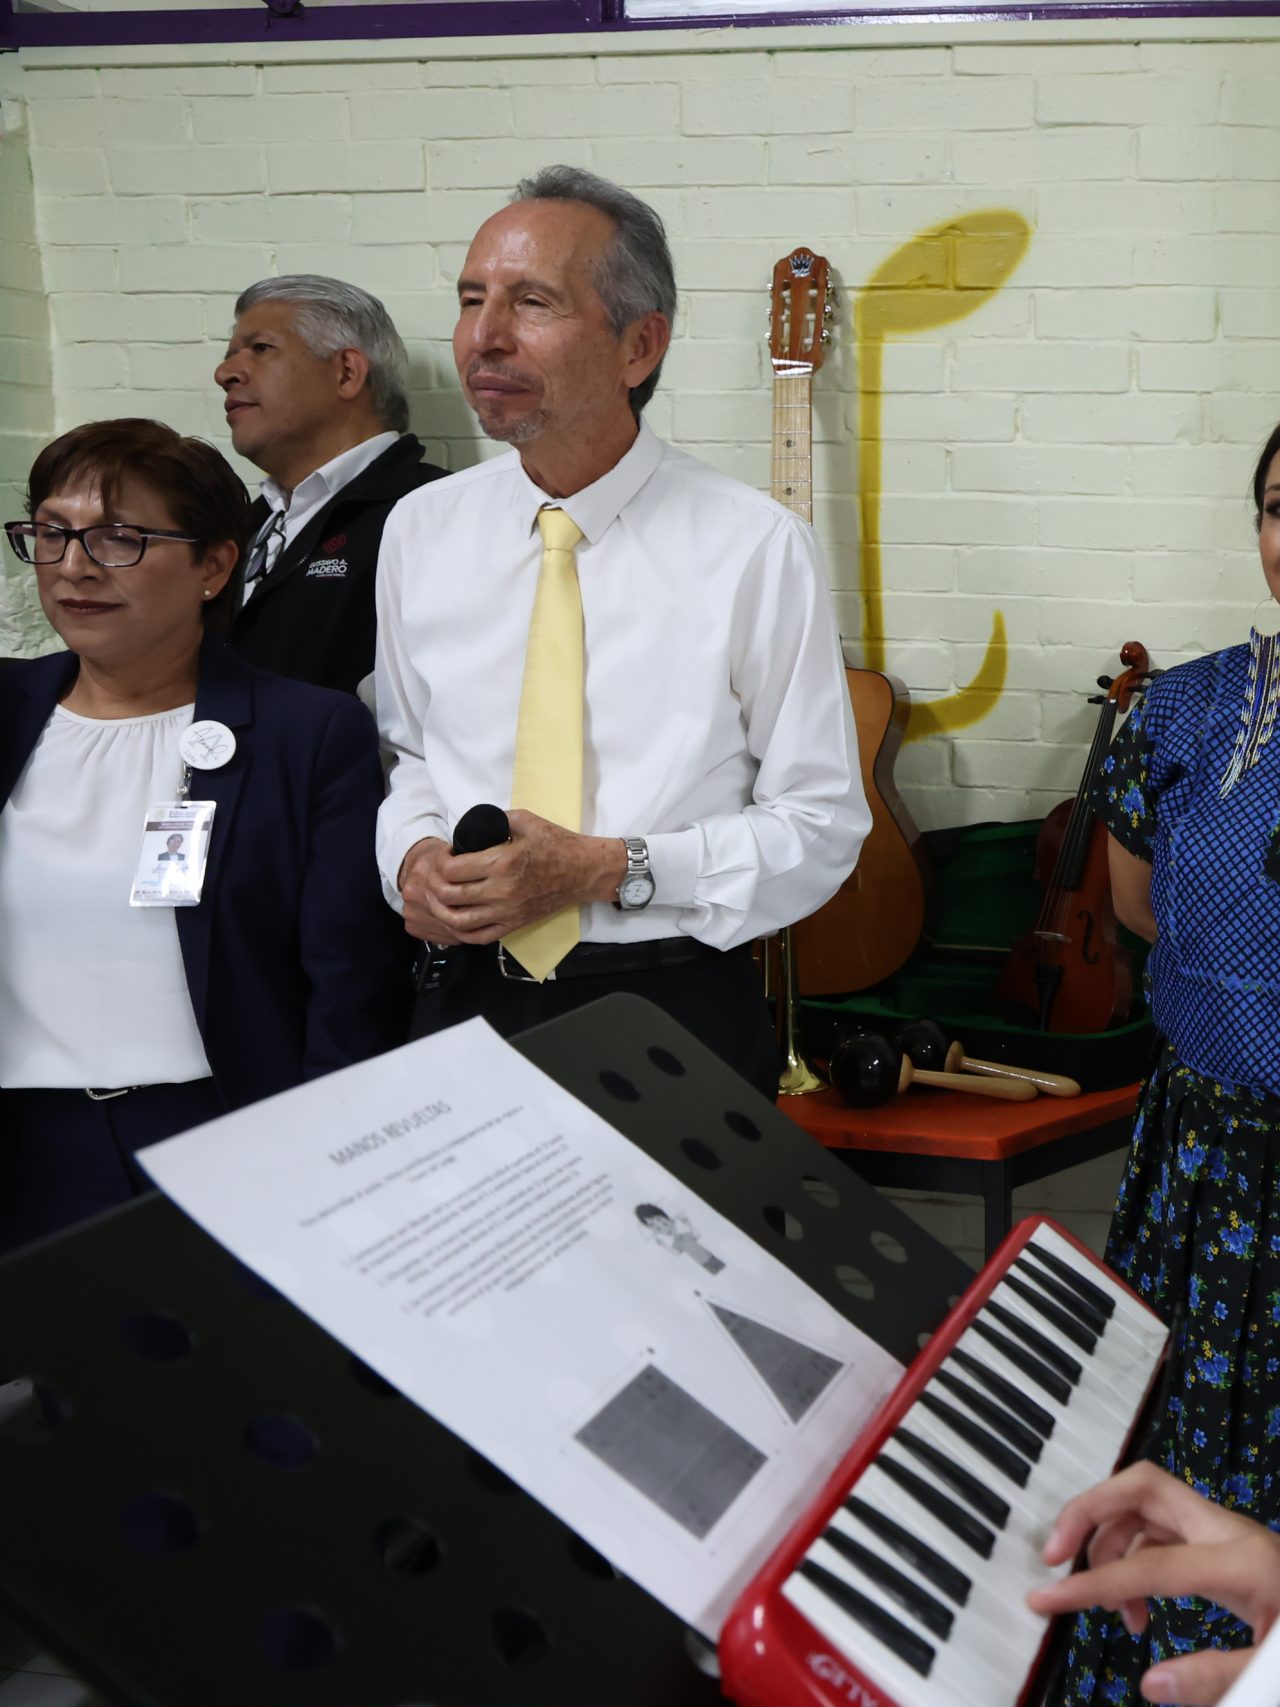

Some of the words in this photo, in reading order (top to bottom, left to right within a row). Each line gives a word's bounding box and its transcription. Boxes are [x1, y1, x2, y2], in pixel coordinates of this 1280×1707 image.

[306, 565, 347, 576] MADERO
[328, 1131, 387, 1168] MANOS
[382, 1099, 453, 1139] REVUELTAS
